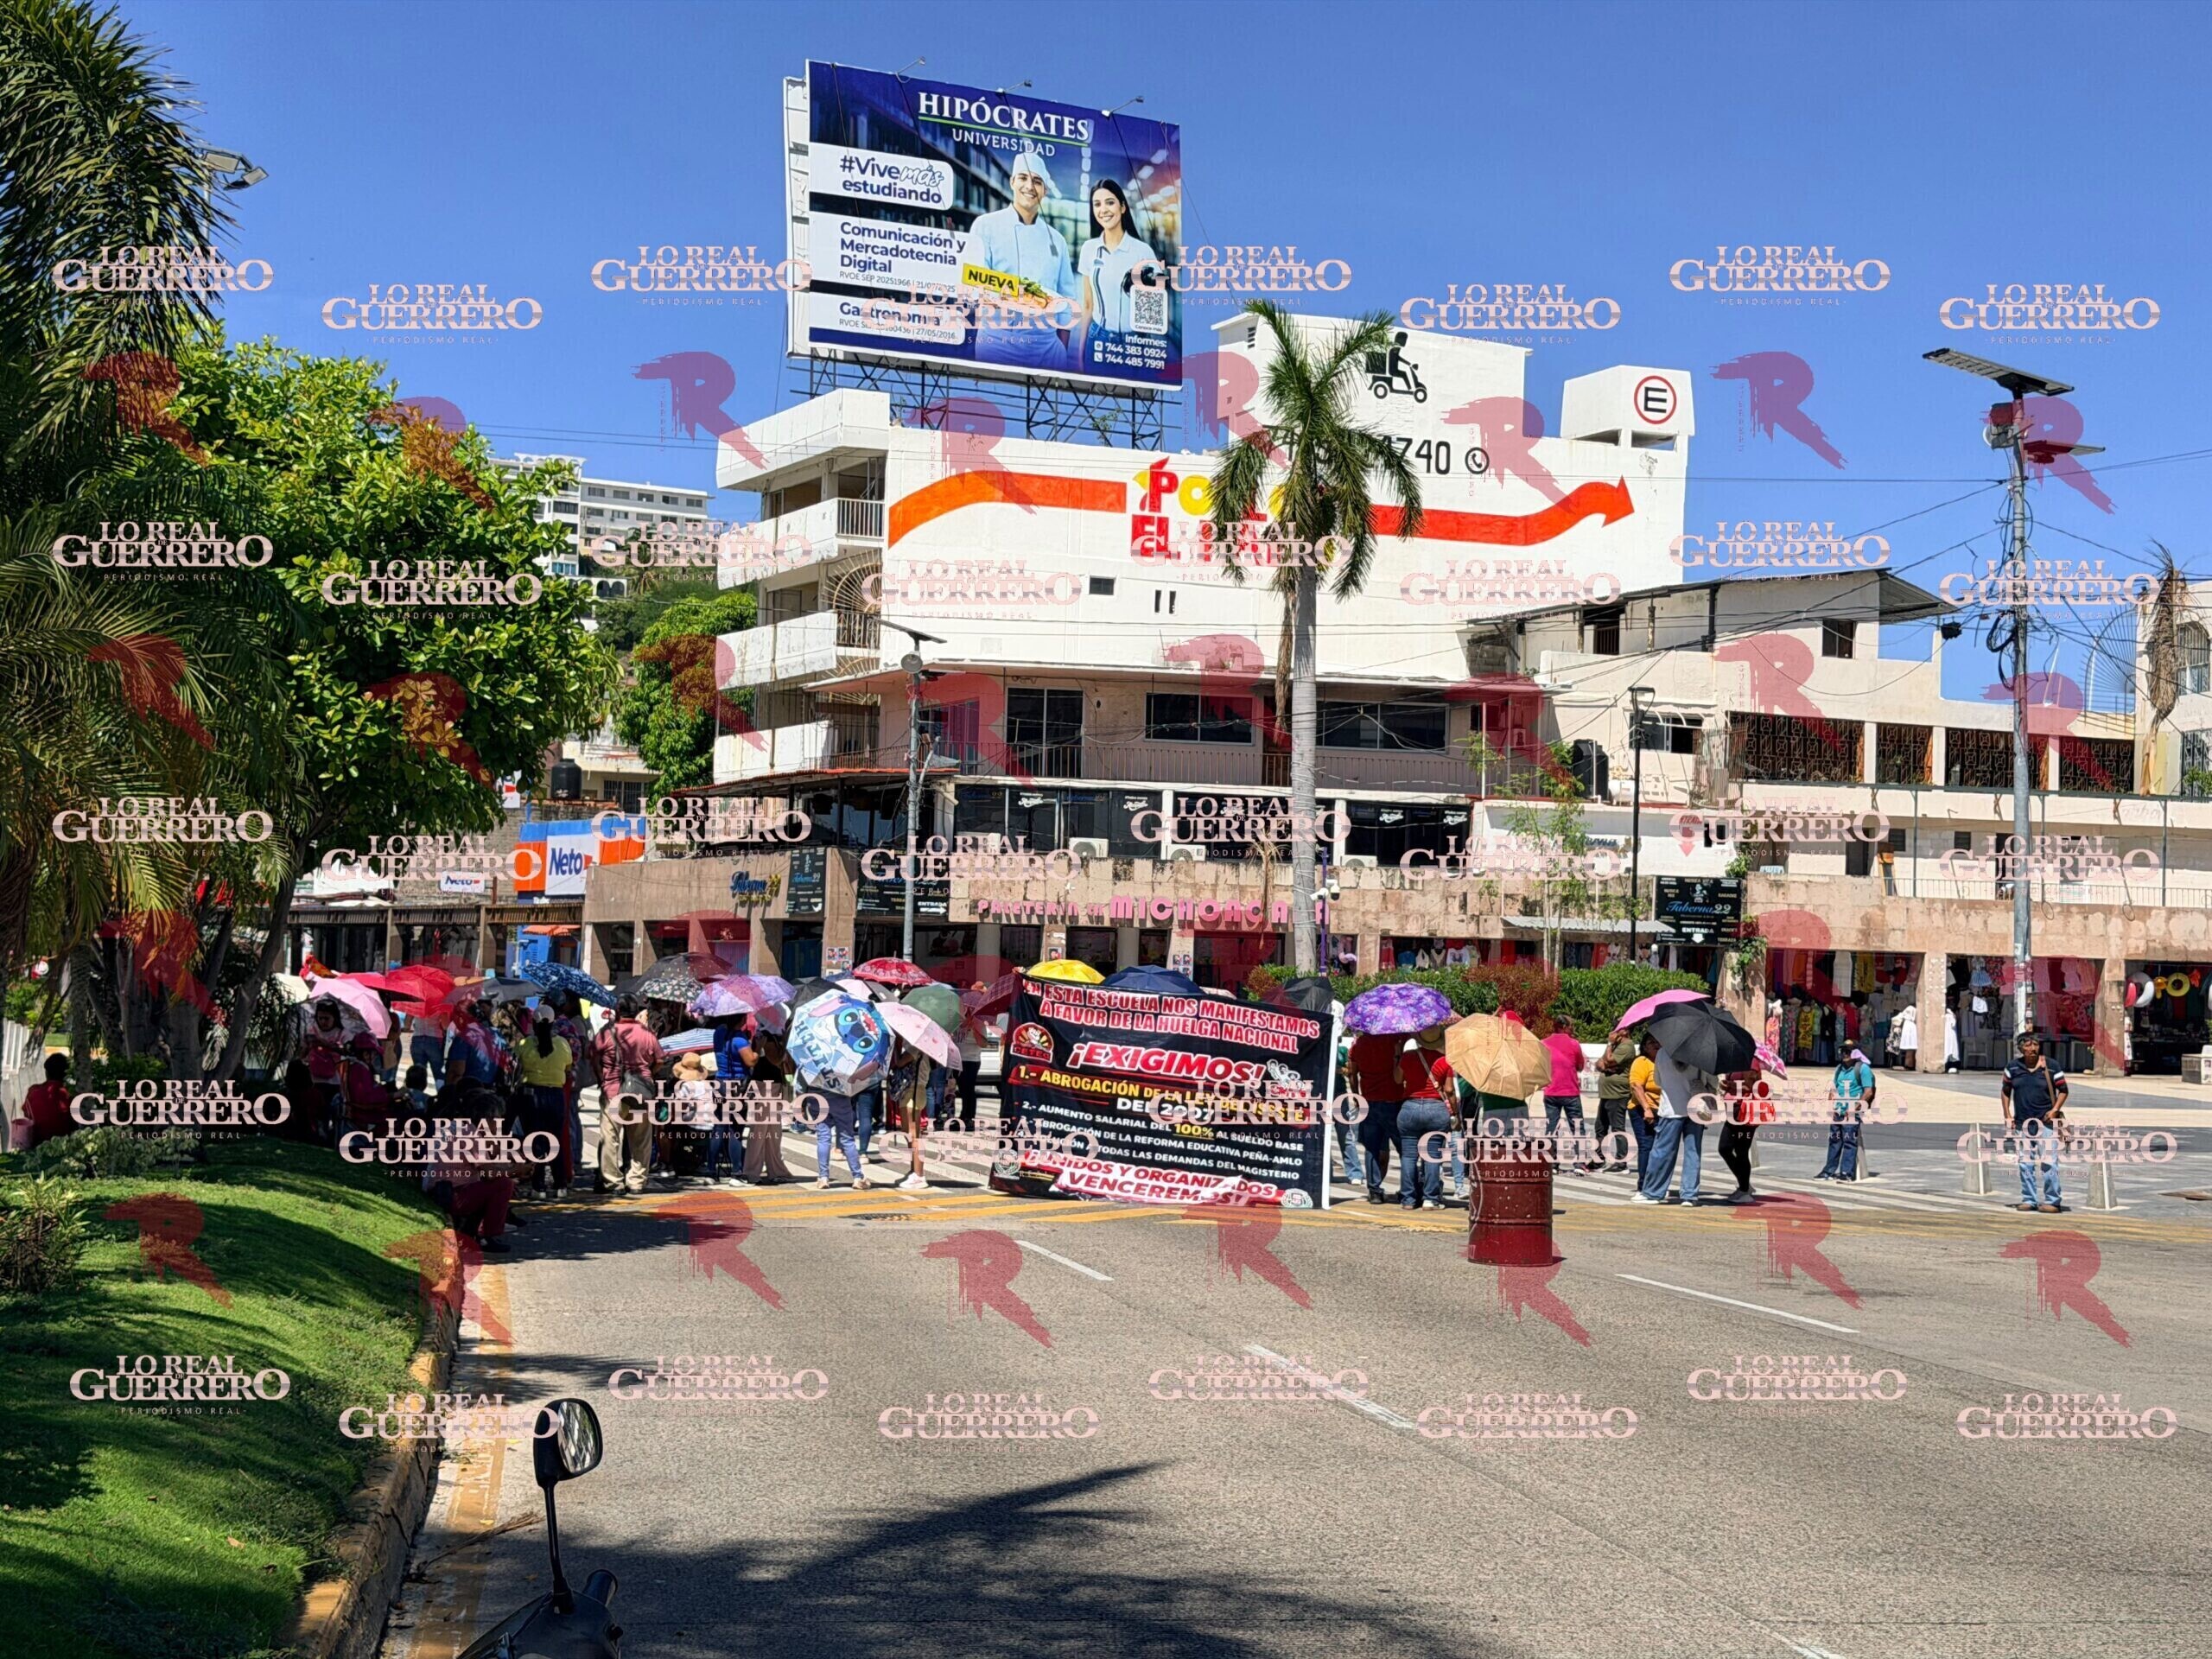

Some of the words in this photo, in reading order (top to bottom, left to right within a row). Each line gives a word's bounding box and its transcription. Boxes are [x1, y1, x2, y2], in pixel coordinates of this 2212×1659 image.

[918, 92, 1089, 141] HIPÓCRATES
[952, 129, 1055, 156] UNIVERSIDAD
[842, 179, 942, 204] estudiando
[840, 221, 952, 249] Comunicación
[957, 240, 966, 253] y
[841, 238, 957, 265] Mercadotecnia
[841, 254, 892, 273] Digital
[839, 270, 860, 281] RVOE
[876, 276, 911, 287] 20251966
[967, 269, 1015, 293] NUEVA
[839, 319, 860, 328] RVOE
[1105, 343, 1123, 353] 744
[1144, 348, 1166, 359] 0924
[1125, 334, 1167, 347] Informes:
[1105, 354, 1123, 364] 744
[1144, 359, 1166, 370] 7991
[1643, 386, 1668, 414] E
[549, 848, 583, 876] Neto
[1109, 895, 1330, 925] MICHOACAA
[1666, 900, 1713, 912] Taberna
[1712, 904, 1732, 914] 22
[1045, 984, 1084, 1005] ESTA
[1086, 989, 1160, 1013] ESCUELA
[1161, 996, 1198, 1017] NOS
[1199, 1000, 1320, 1039] MANIFESTAMOS
[1039, 1001, 1052, 1017] A
[1054, 1003, 1108, 1027] FAVOR
[1109, 1011, 1132, 1028] DE
[1133, 1014, 1155, 1032] LA
[1156, 1015, 1220, 1039] HUELGA
[1222, 1024, 1299, 1054] NACIONAL
[1066, 1042, 1267, 1087] ¡EXIGIMOS!
[1019, 1066, 1037, 1078] 1.-
[1040, 1070, 1140, 1097] ABROGACIÓN
[1038, 1105, 1093, 1121] AUMENTO
[1095, 1113, 1147, 1128] SALARIAL
[1150, 1122, 1172, 1132] DEL
[1174, 1123, 1215, 1136] 100%
[1230, 1134, 1273, 1147] SUELDO
[1275, 1141, 1304, 1151] BASE
[1103, 1130, 1116, 1139] DE
[1118, 1133, 1132, 1141] LA
[1134, 1135, 1185, 1149] REFORMA
[1187, 1141, 1241, 1157] EDUCATIVA
[1243, 1150, 1303, 1166] PEÑA-AMLO
[1098, 1146, 1130, 1157] TODAS
[1132, 1148, 1152, 1160] LAS
[1154, 1150, 1214, 1167] DEMANDAS
[1237, 1164, 1300, 1179] MAGISTERIO
[1119, 1165, 1132, 1177] Y
